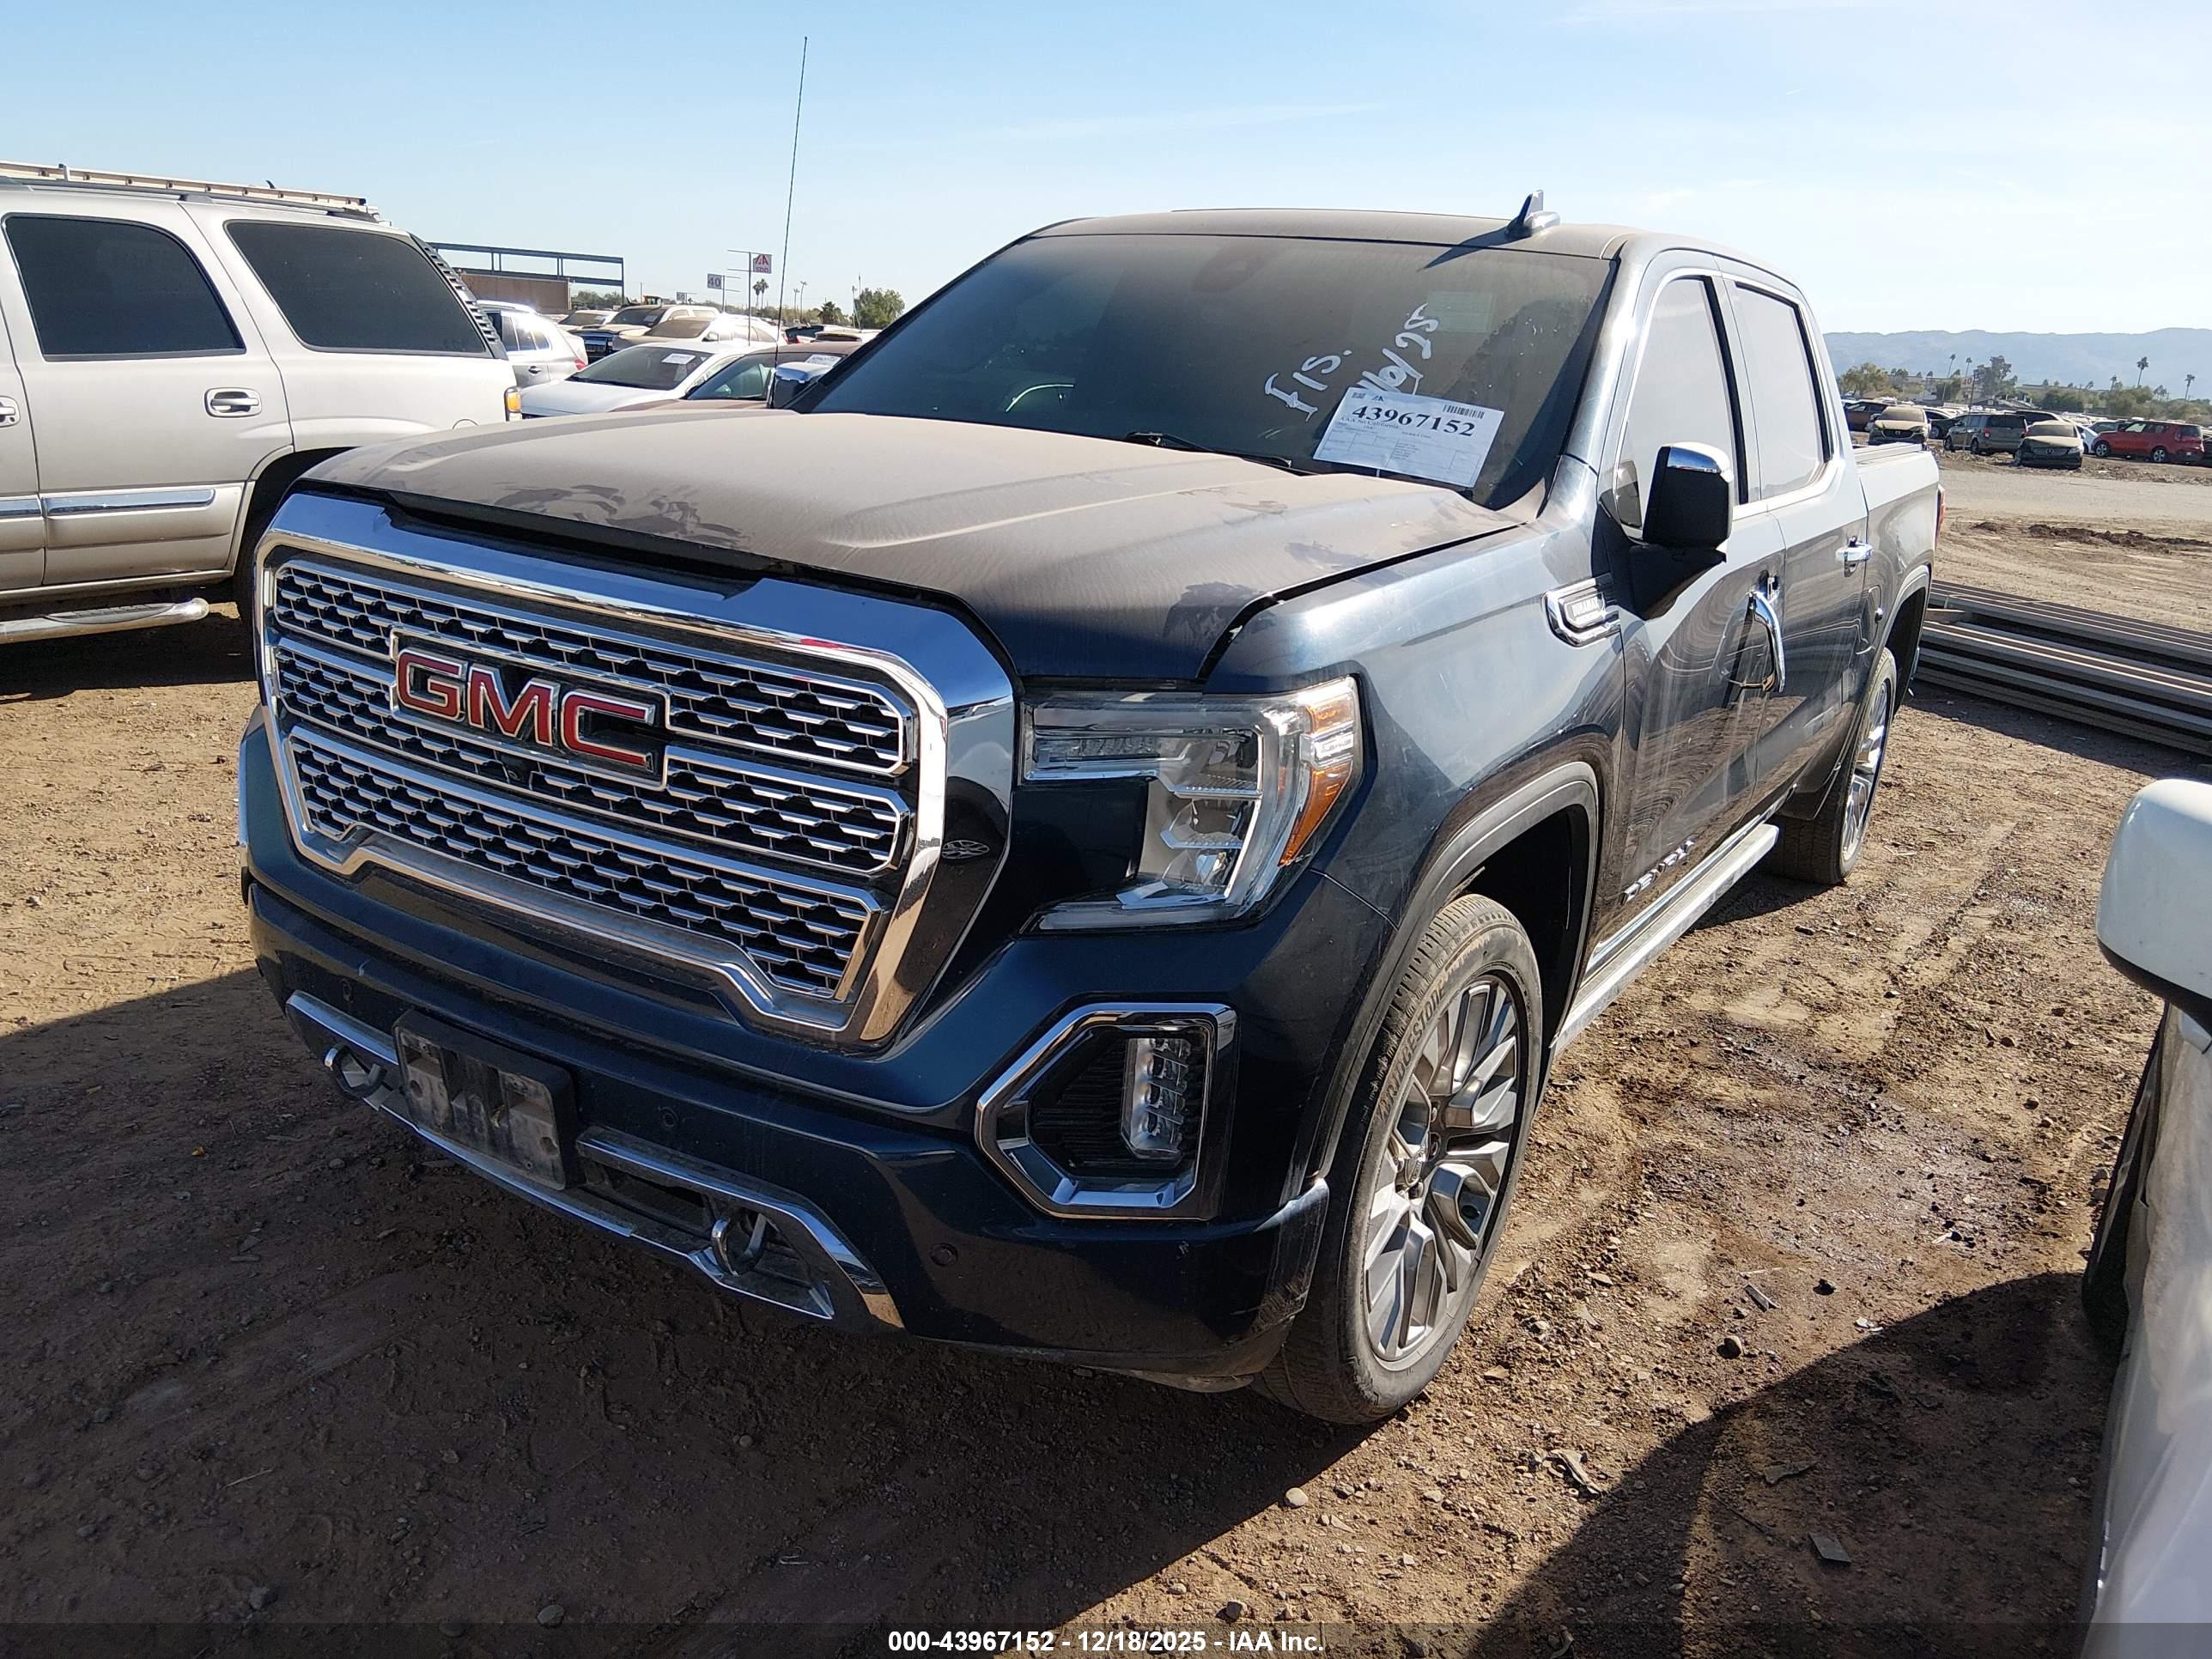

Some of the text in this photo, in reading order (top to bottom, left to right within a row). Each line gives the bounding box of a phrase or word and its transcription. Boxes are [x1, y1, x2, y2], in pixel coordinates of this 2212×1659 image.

[708, 276, 721, 287] 40
[1352, 405, 1475, 436] 43967152
[397, 647, 655, 773] GMC
